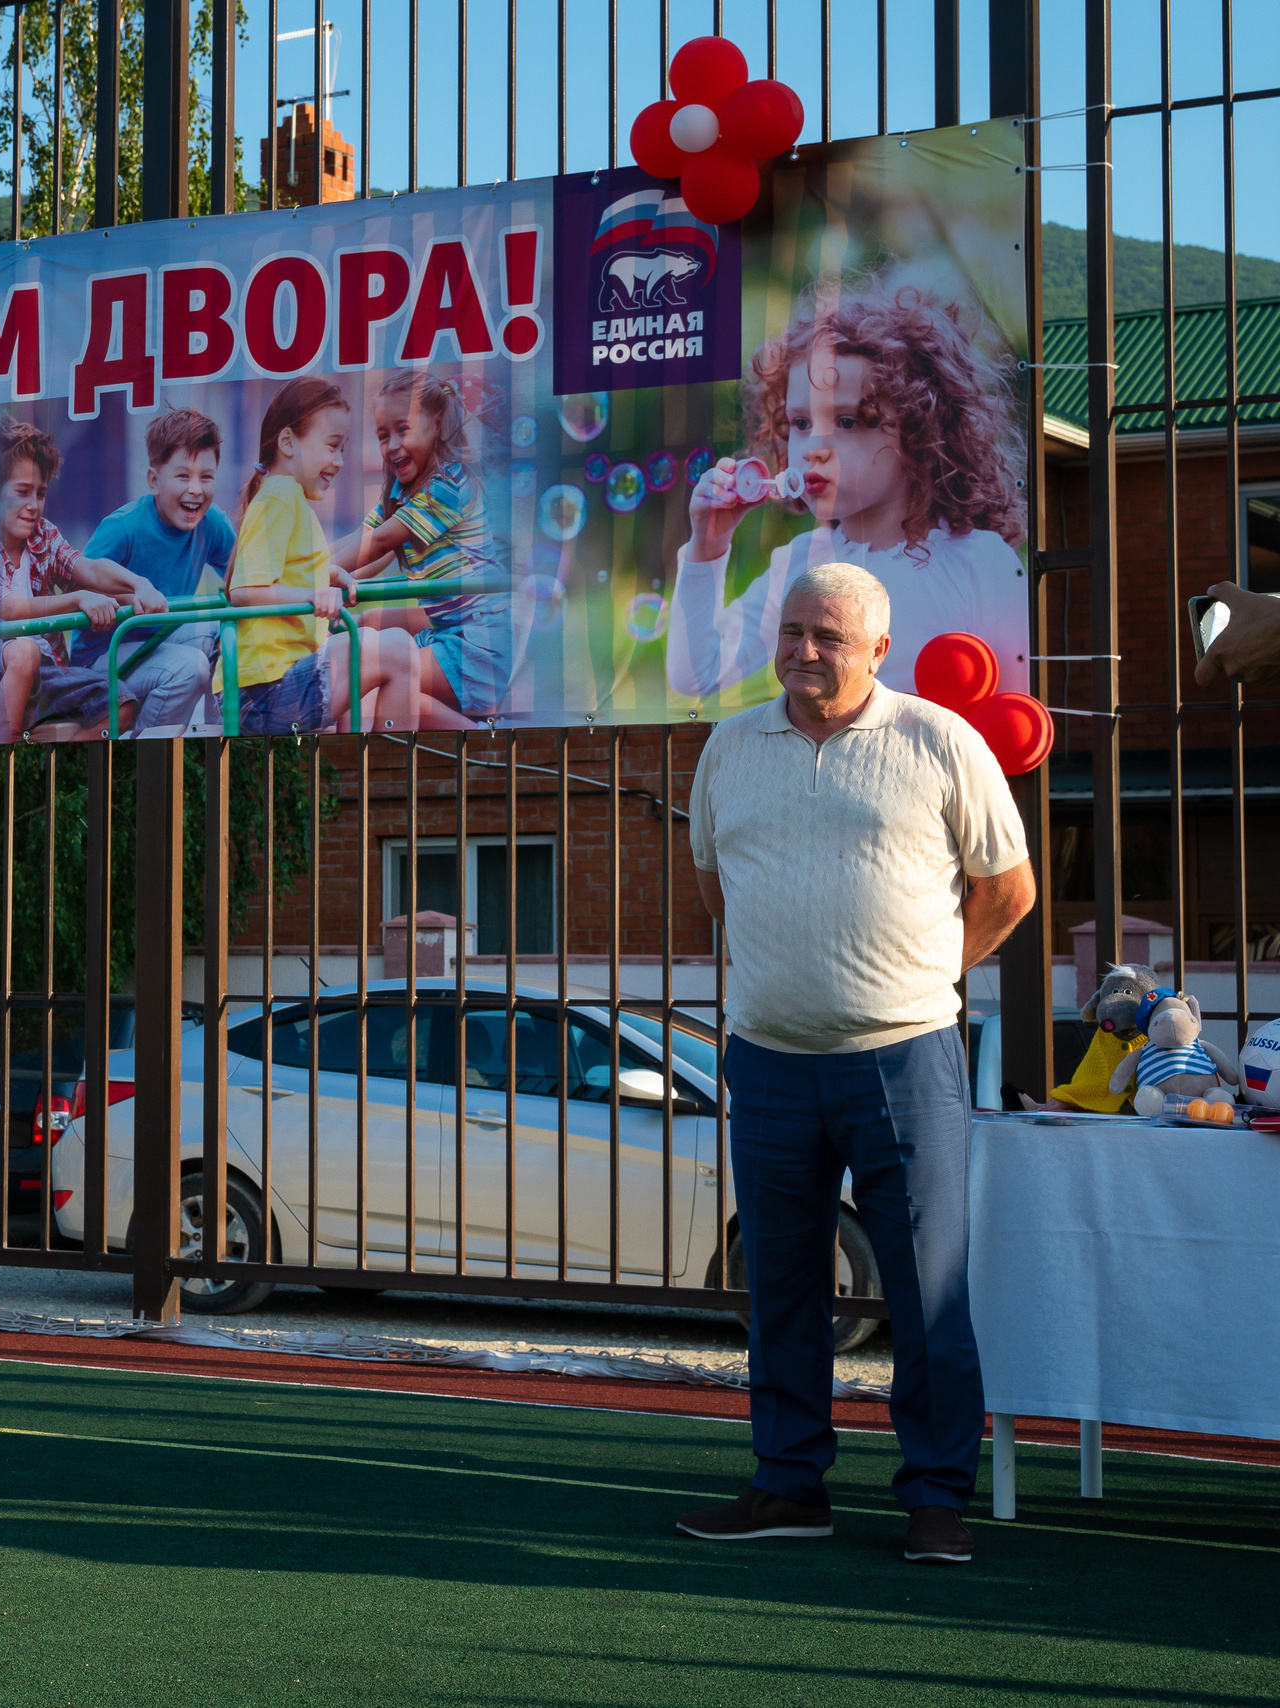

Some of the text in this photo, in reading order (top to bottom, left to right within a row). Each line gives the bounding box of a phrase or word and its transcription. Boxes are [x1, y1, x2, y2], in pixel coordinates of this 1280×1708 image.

[72, 229, 540, 415] ДВОРА!
[592, 310, 704, 342] ЕДИНАЯ
[592, 335, 703, 366] РОССИЯ
